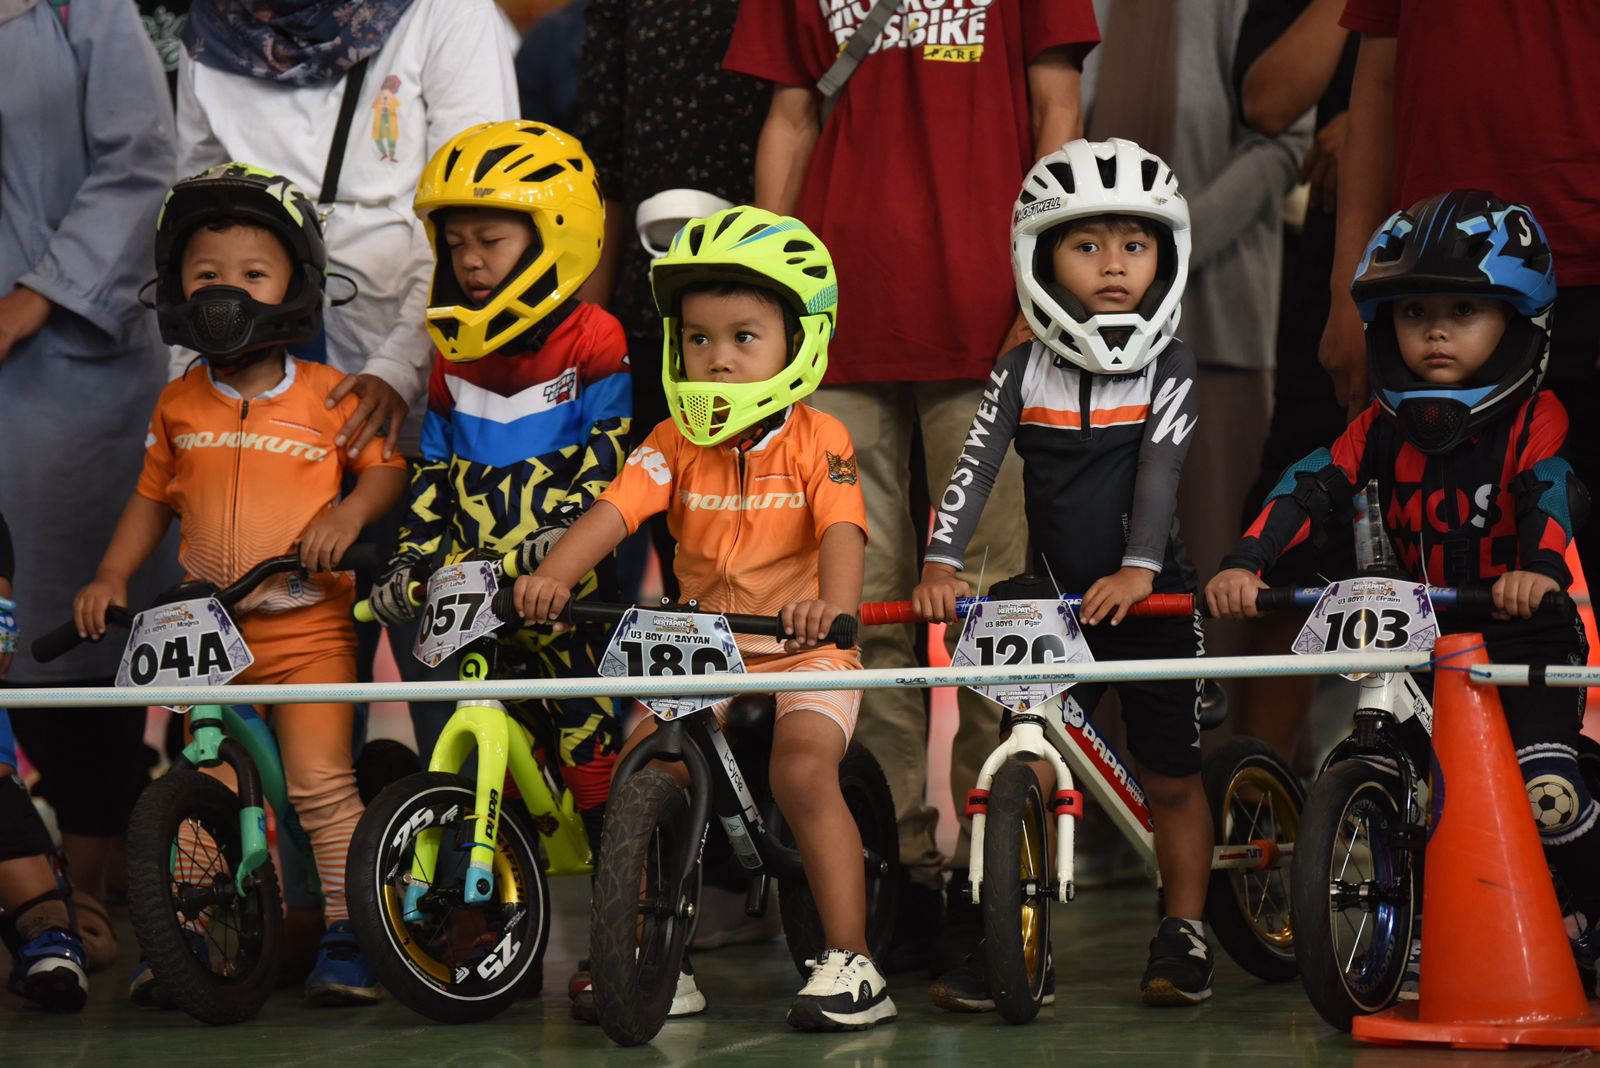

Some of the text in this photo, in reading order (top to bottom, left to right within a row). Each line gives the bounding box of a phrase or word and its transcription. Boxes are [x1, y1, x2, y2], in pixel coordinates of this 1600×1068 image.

[174, 431, 328, 462] MOJOKUTO
[932, 368, 1009, 544] MOSTWELL
[419, 592, 486, 646] 057
[630, 630, 642, 639] U3
[645, 632, 664, 642] BOY
[674, 634, 711, 645] ZAYYAN
[985, 620, 994, 628] U3
[995, 619, 1014, 628] BOYS
[1324, 608, 1411, 652] 103
[130, 631, 233, 686] 04A
[1083, 721, 1127, 786] PAPA
